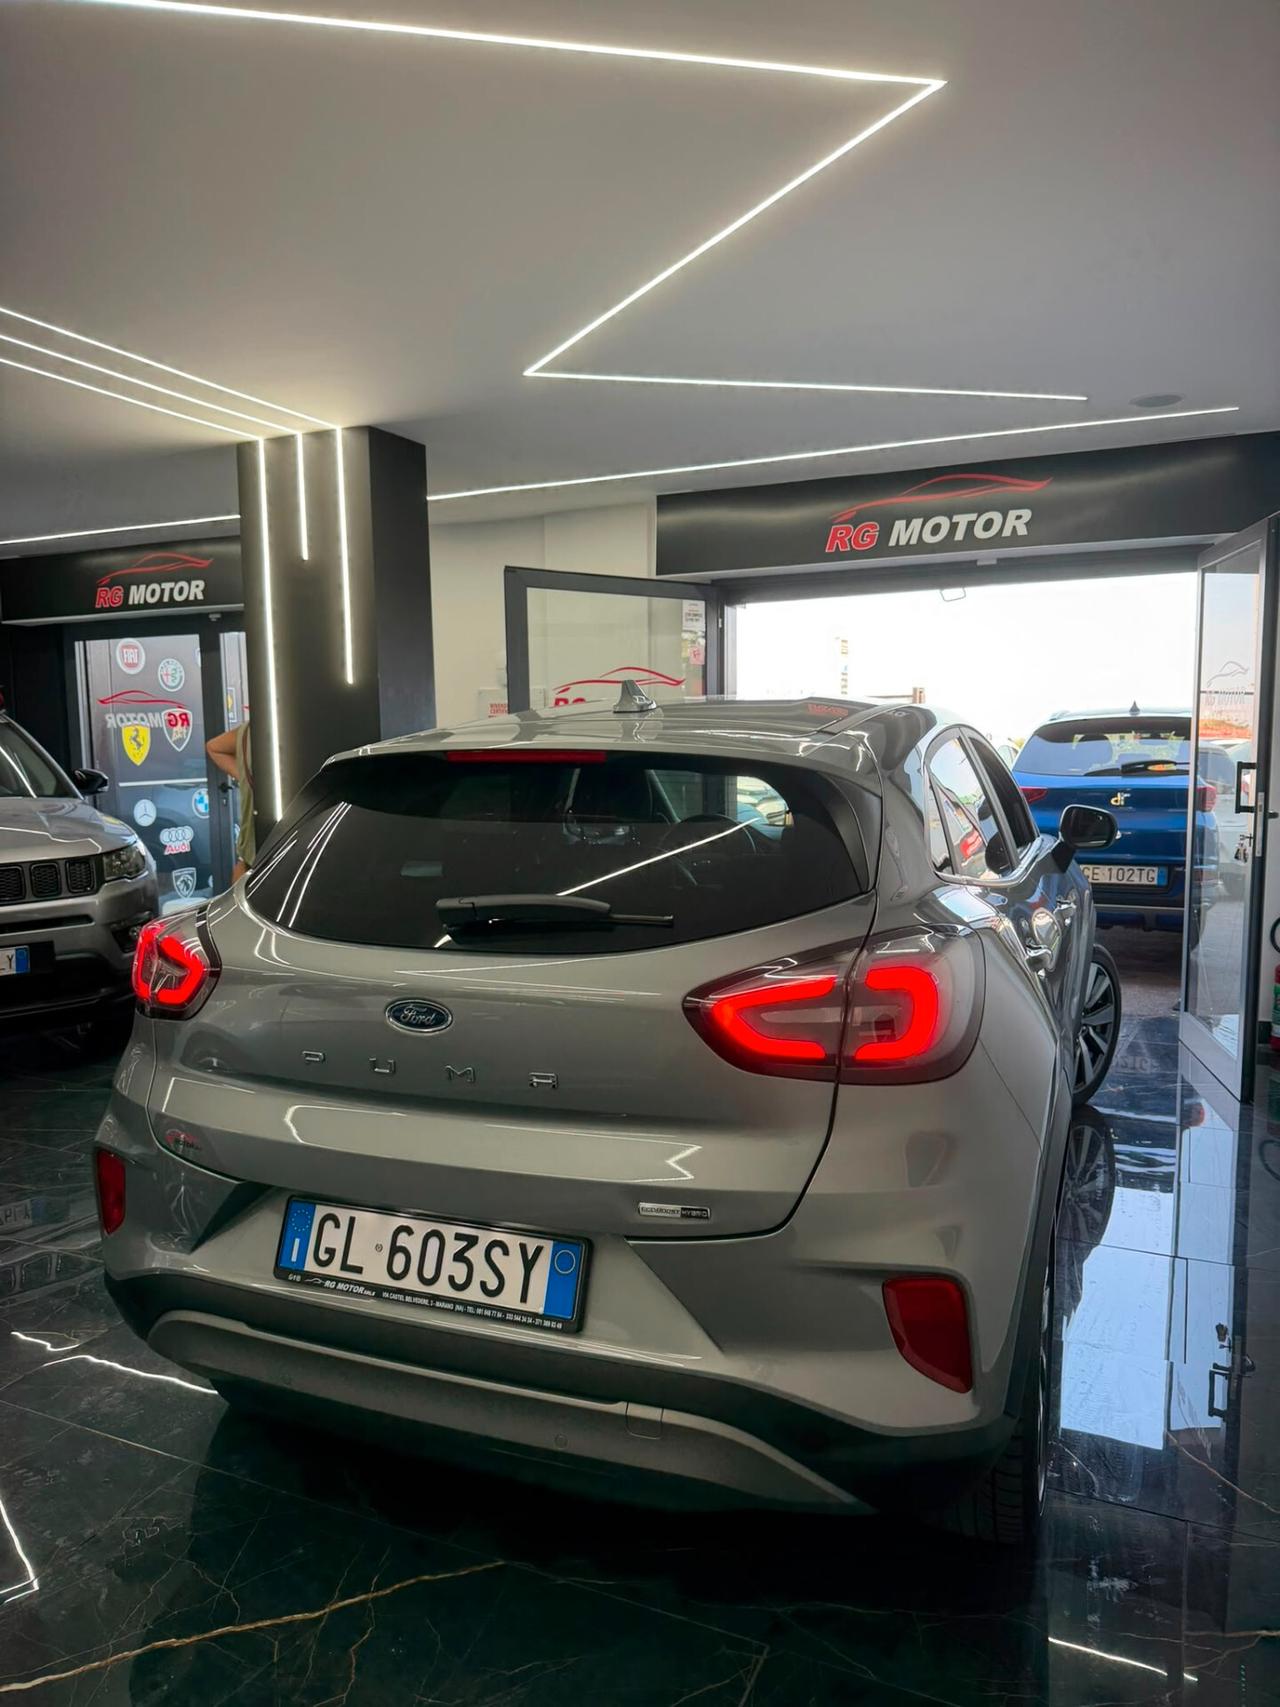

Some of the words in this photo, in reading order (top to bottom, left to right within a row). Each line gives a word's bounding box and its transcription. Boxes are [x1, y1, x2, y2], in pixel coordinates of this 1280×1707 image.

[825, 522, 880, 552] RG
[888, 509, 1032, 546] MOTOR
[95, 586, 123, 608] RG
[128, 580, 205, 605] MOTOR
[164, 841, 191, 855] Audi
[1107, 867, 1155, 883] 102TG
[400, 1003, 437, 1026] Ford
[312, 1212, 364, 1275] GL
[386, 1225, 544, 1304] 603SY
[336, 1281, 365, 1296] MOTOR
